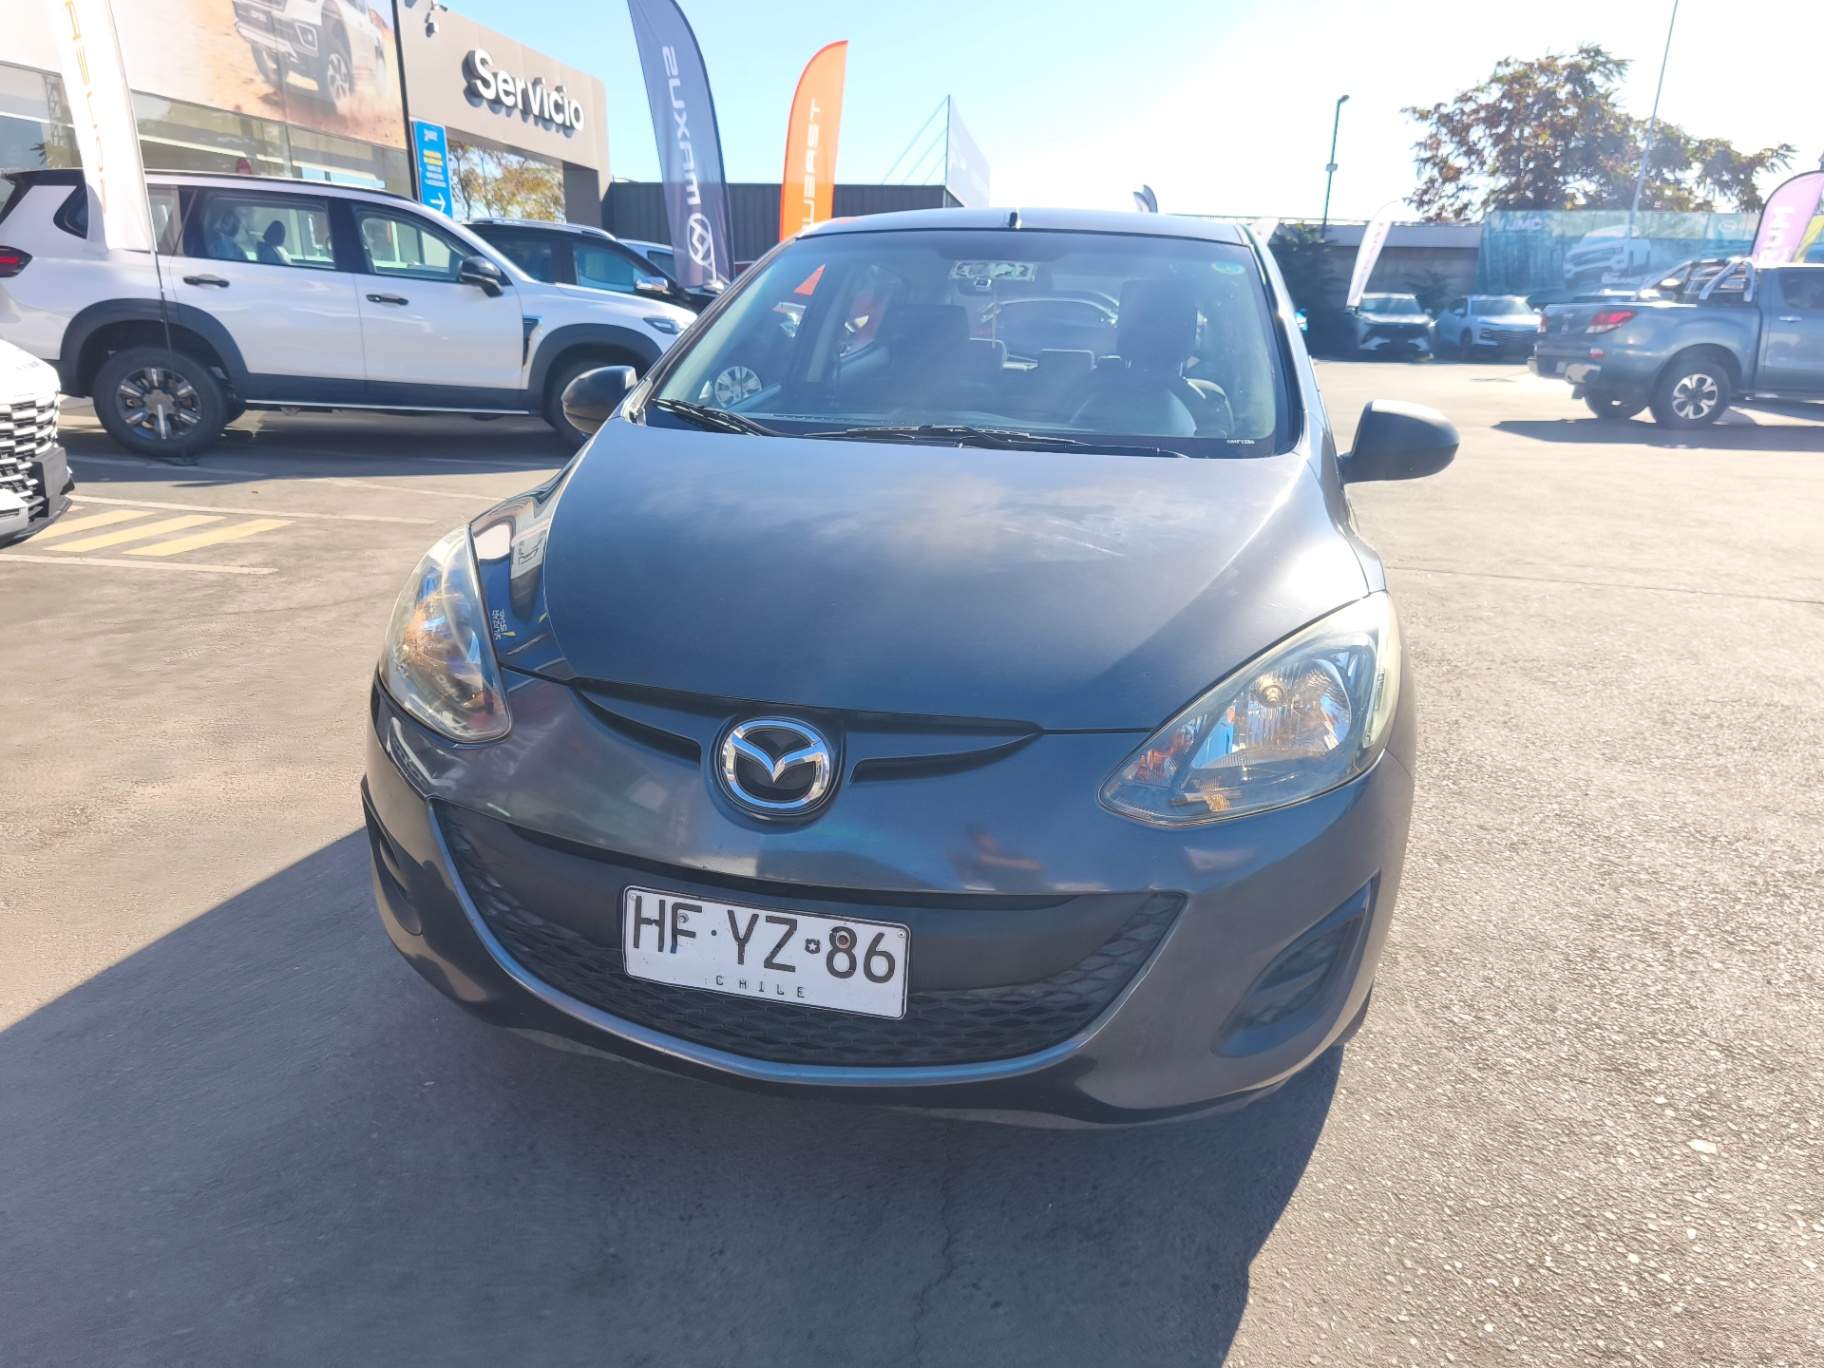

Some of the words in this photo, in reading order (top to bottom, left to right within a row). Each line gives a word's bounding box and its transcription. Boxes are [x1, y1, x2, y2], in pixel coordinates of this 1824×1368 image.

[473, 48, 585, 132] Servicio
[801, 97, 822, 234] UEAST
[715, 974, 805, 999] CHILE
